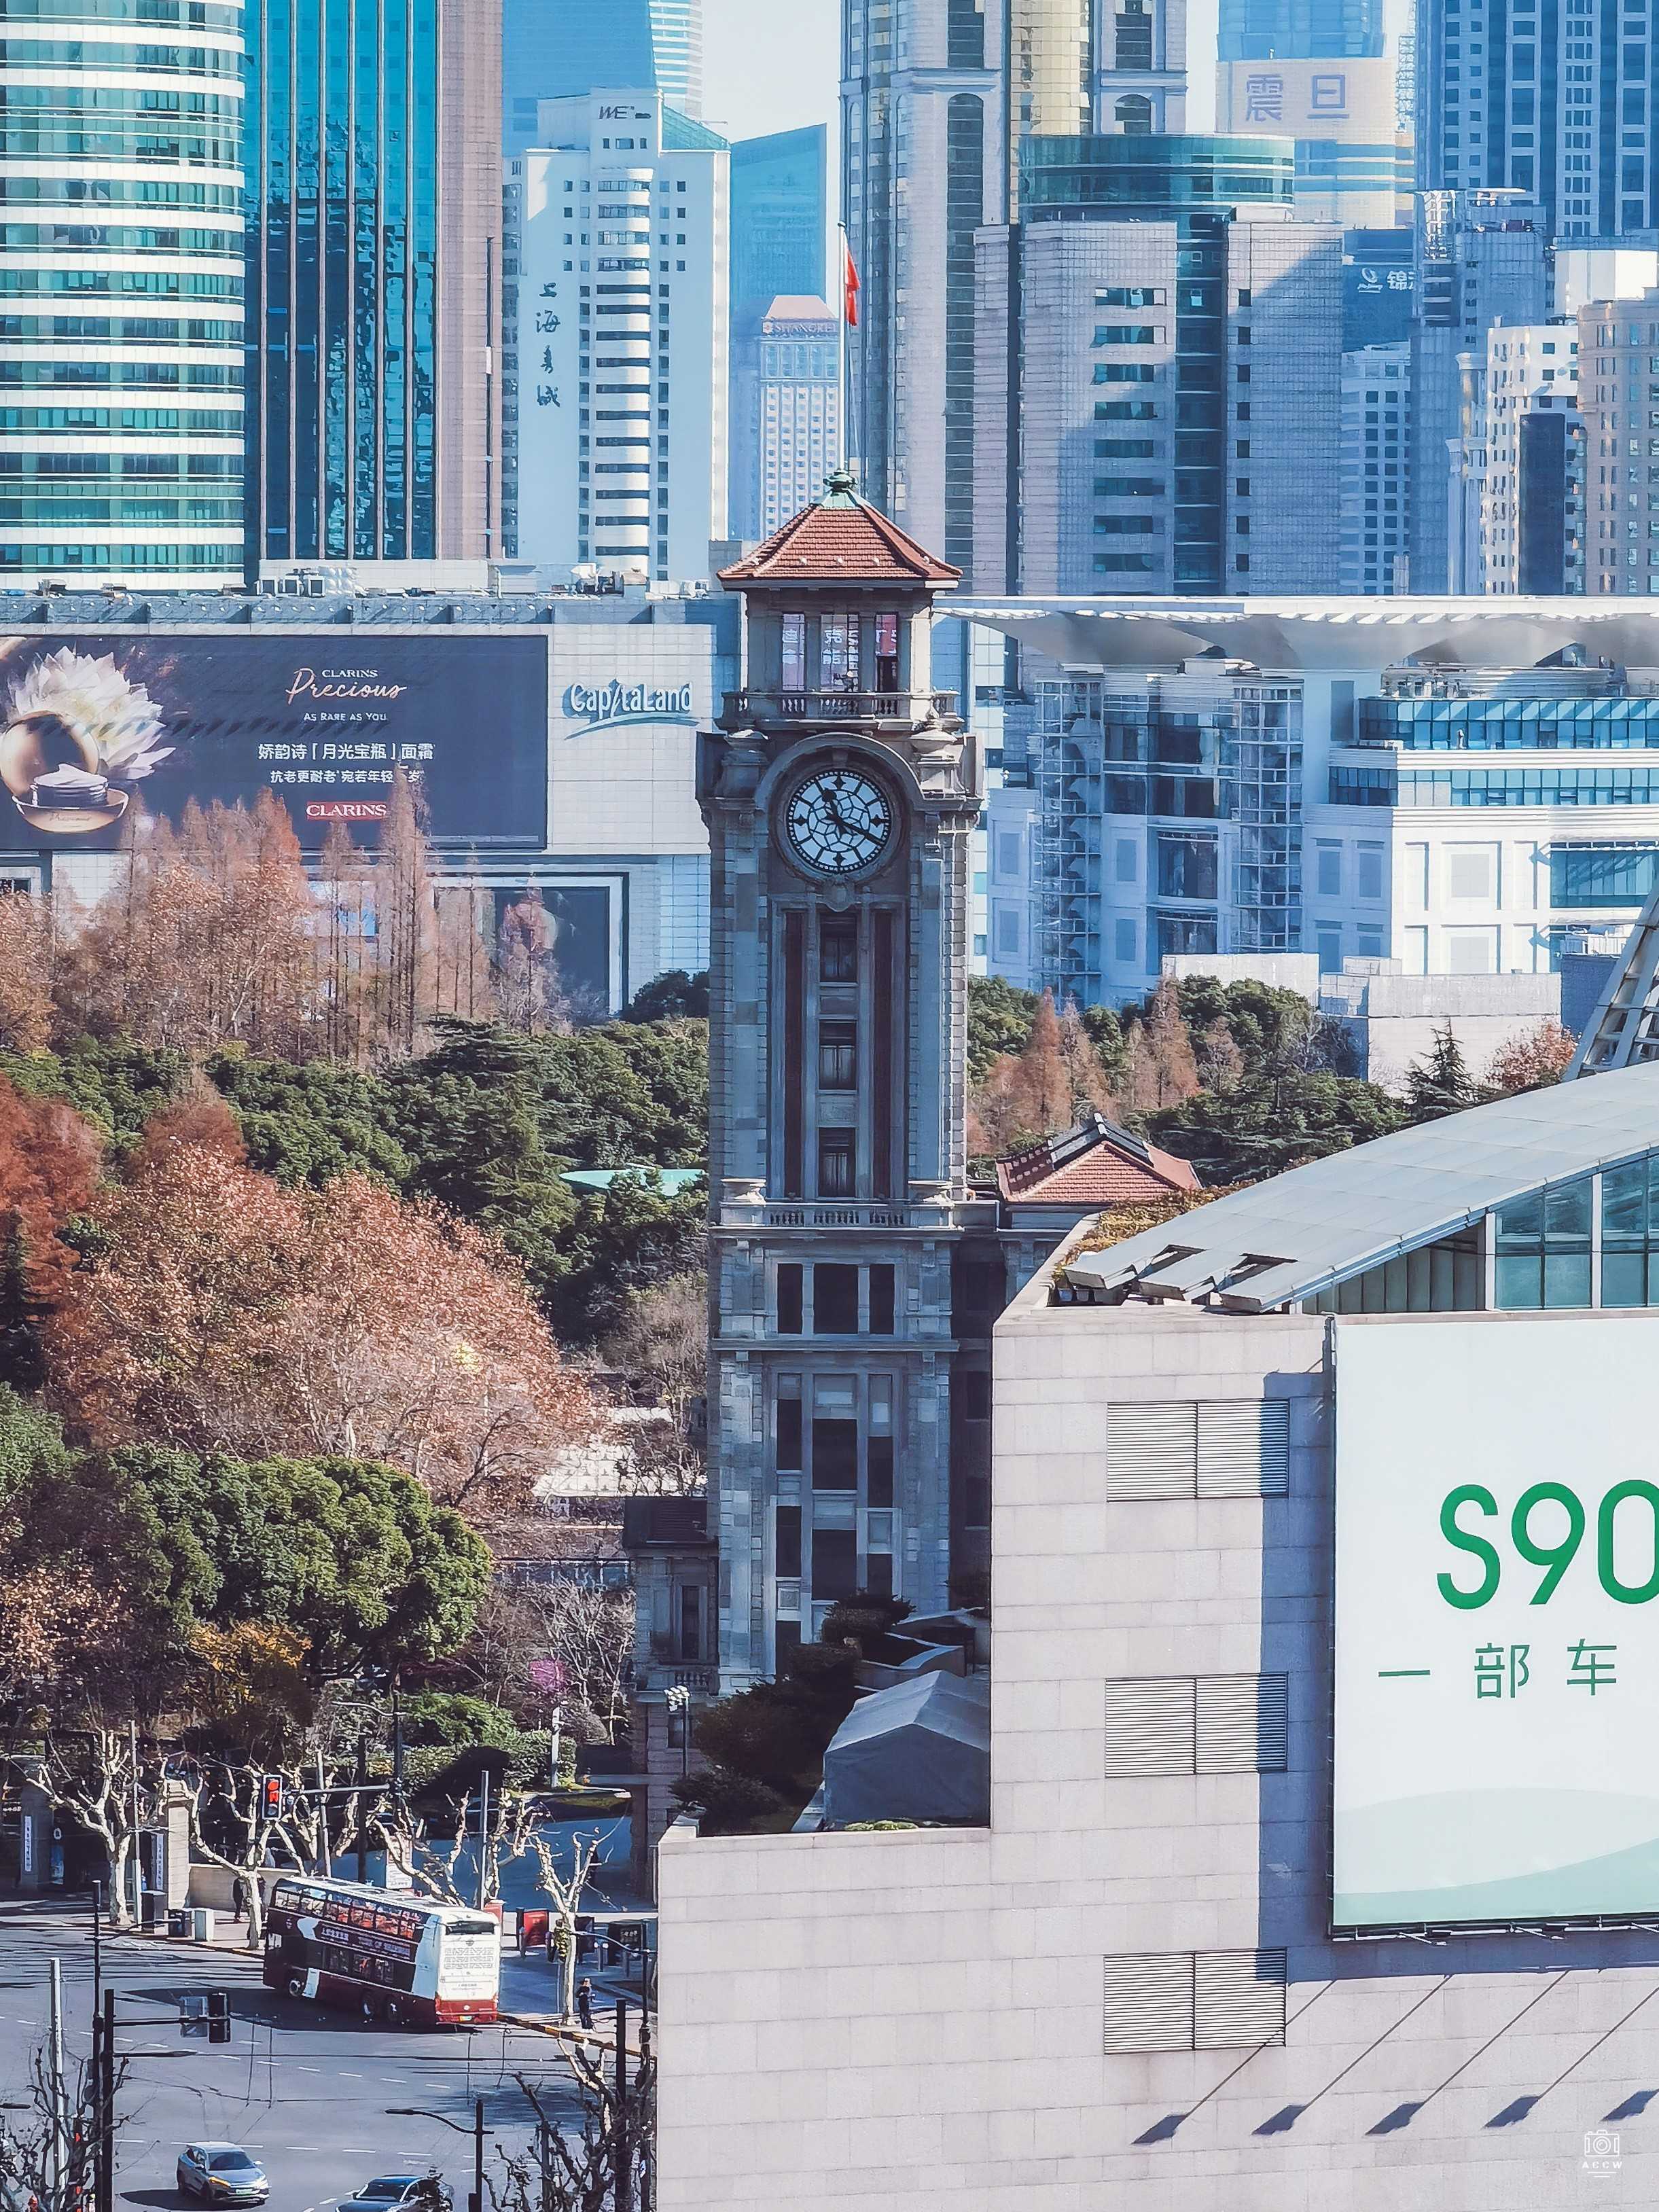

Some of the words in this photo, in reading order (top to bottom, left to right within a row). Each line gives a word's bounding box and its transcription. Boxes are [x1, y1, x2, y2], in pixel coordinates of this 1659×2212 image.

[1246, 74, 1350, 121] 震旦
[285, 667, 407, 705] Precious
[321, 669, 378, 678] CLARINS
[303, 713, 317, 721] AS
[320, 713, 345, 721] RARE
[569, 681, 692, 720] CapitaLand
[306, 804, 387, 816] CLARINS
[1437, 1479, 1659, 1609] S90
